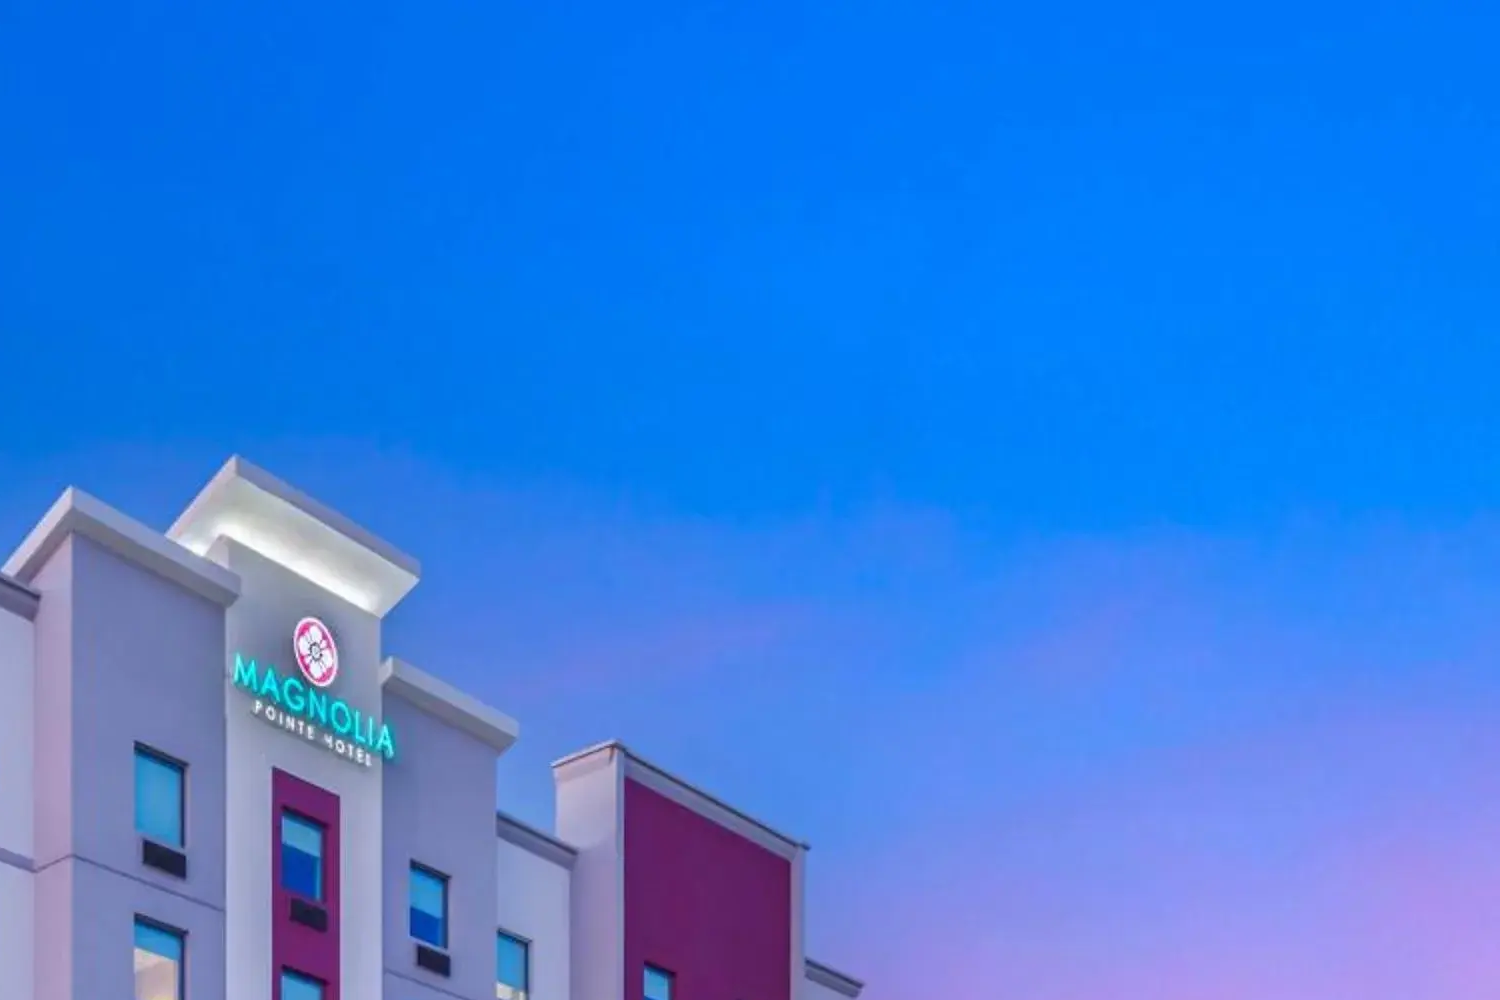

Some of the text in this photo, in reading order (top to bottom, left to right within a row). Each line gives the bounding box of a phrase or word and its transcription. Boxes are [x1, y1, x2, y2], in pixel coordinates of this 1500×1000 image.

[234, 652, 394, 758] MAGNOLIA
[253, 699, 372, 767] POINTE HOTEL
